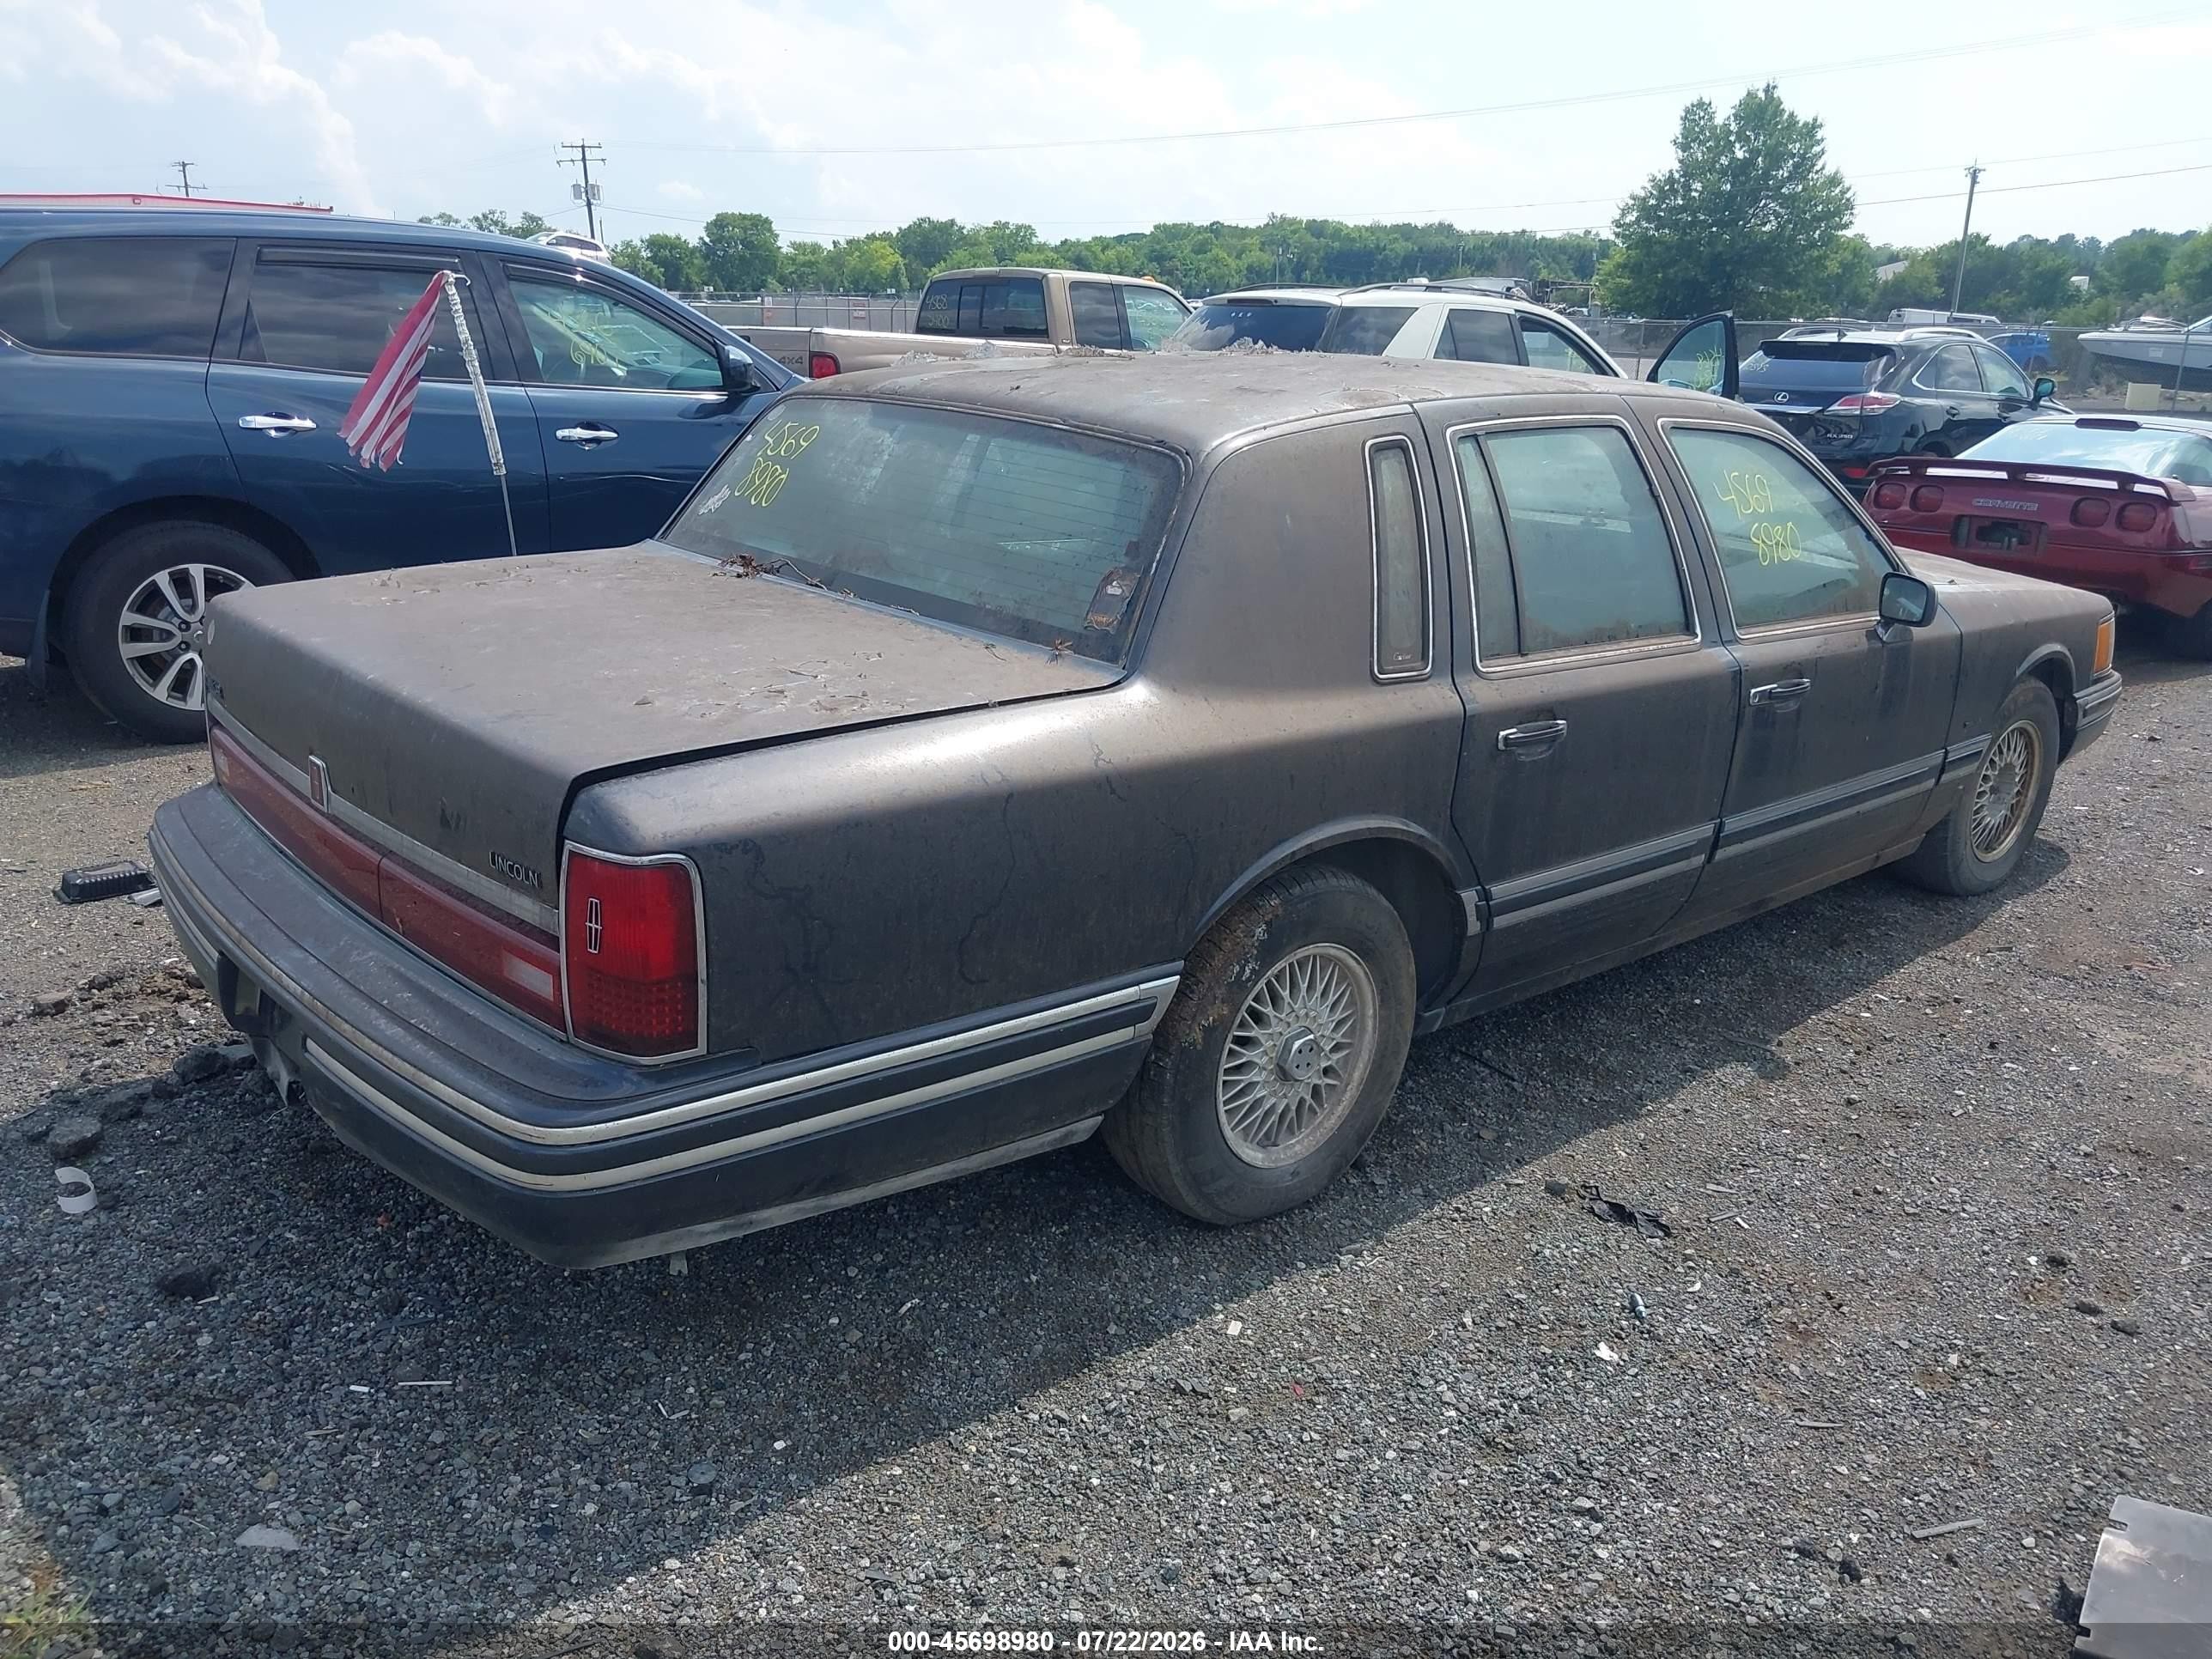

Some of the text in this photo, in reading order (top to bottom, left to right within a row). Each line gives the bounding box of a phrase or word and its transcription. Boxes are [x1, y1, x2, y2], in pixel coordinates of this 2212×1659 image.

[757, 419, 820, 460] 4569
[734, 457, 790, 507] 8980
[1712, 470, 1774, 521] 4569
[1750, 521, 1802, 567] 8980
[489, 850, 539, 889] LINCOLN
